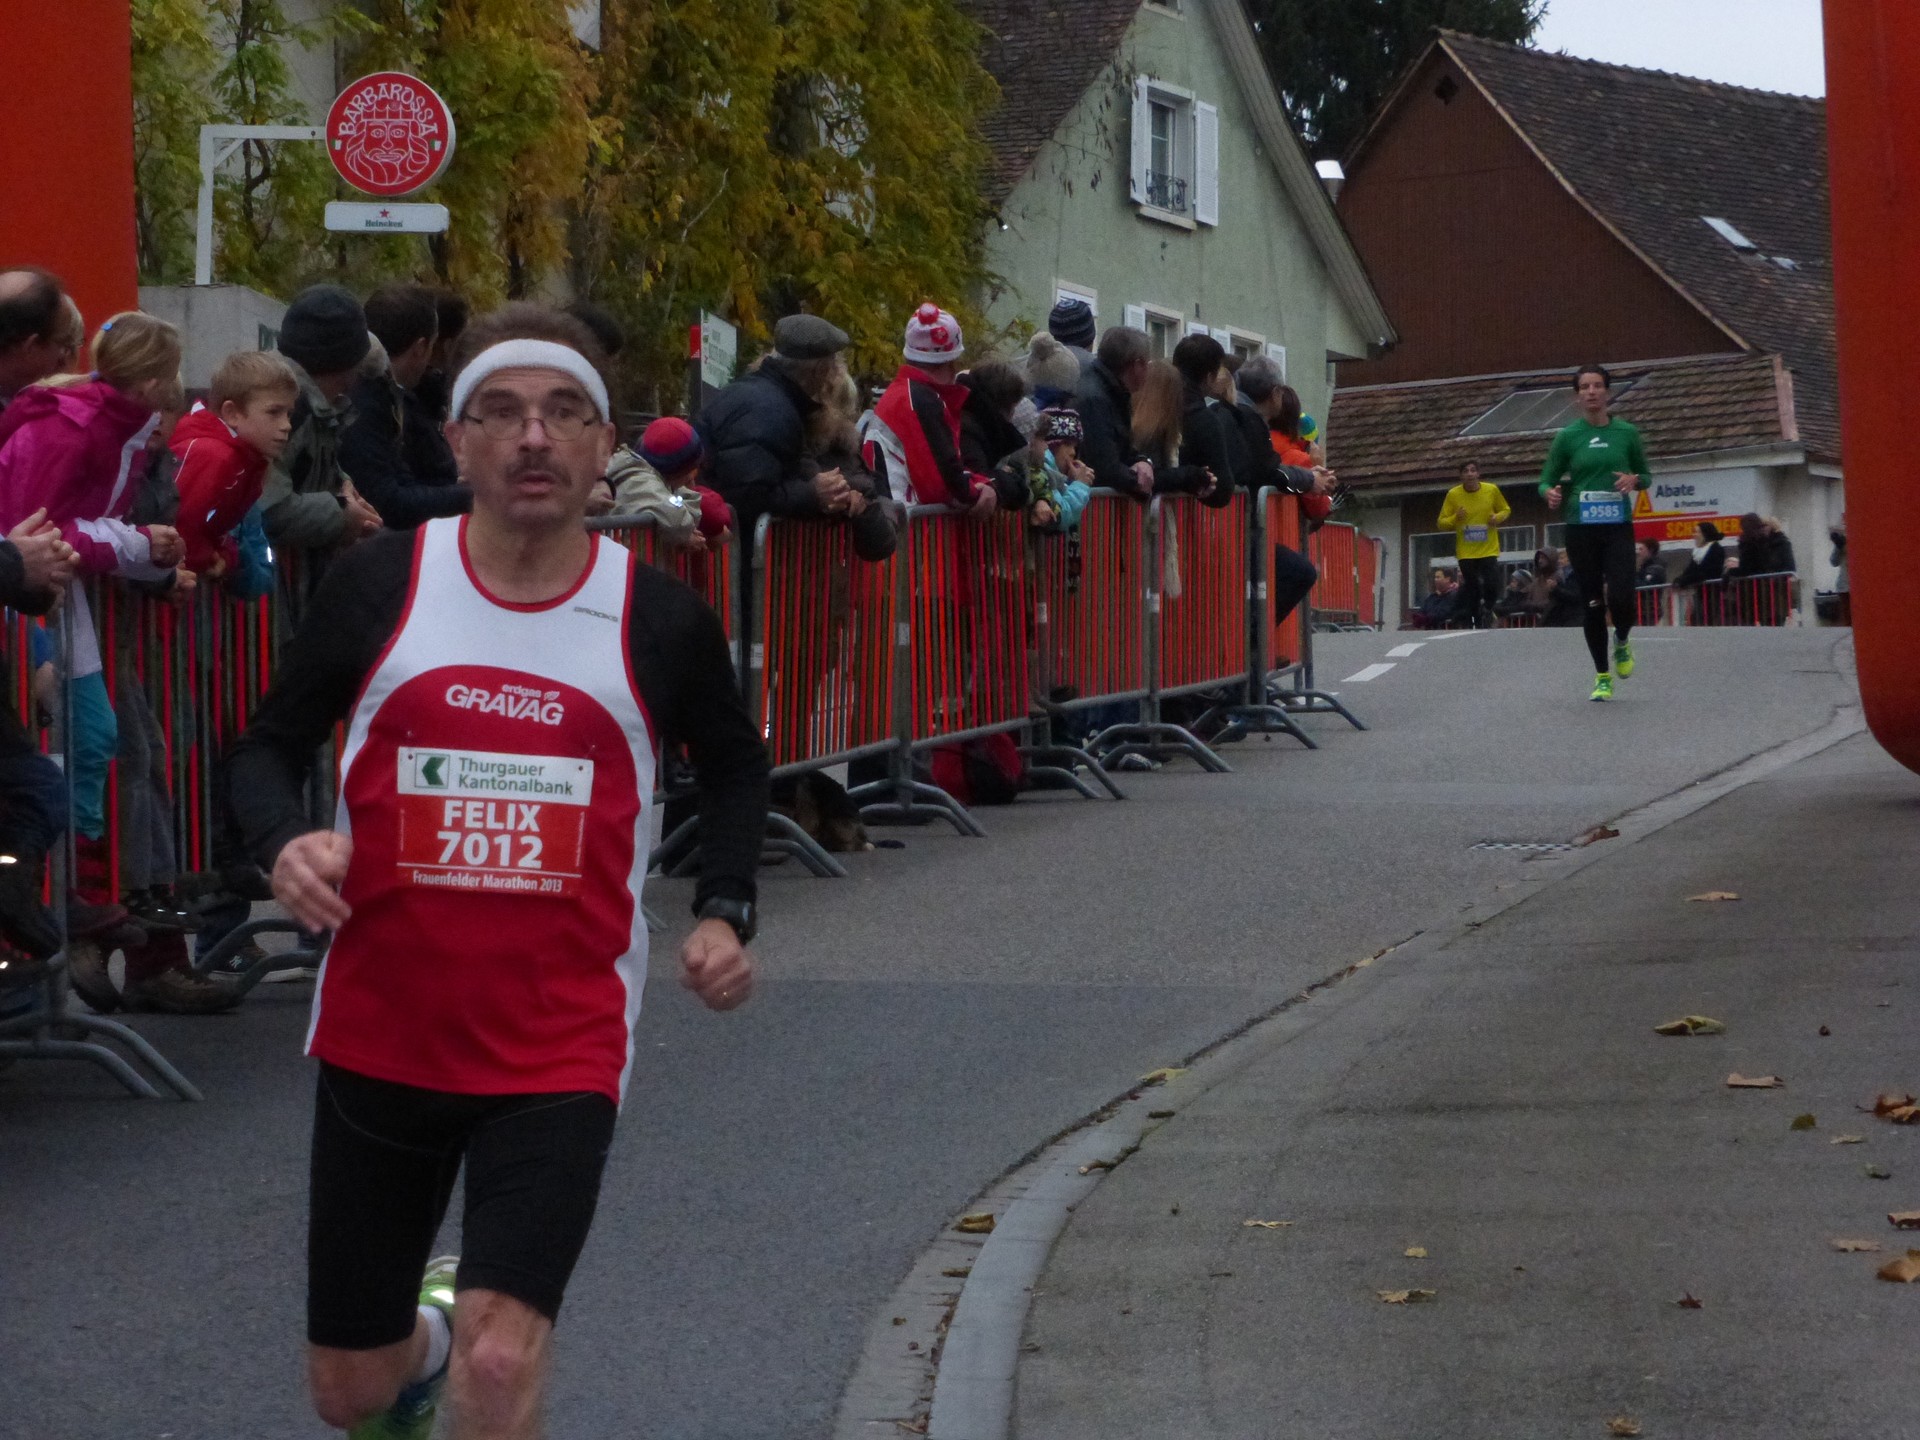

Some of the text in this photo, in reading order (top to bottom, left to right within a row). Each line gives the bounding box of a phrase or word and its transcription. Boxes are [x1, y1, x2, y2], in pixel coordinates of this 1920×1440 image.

[338, 82, 438, 137] BARBAROSSA
[365, 219, 403, 228] Heineken
[1655, 483, 1695, 498] Abate
[1590, 505, 1619, 518] 9585
[501, 683, 542, 698] erdgas
[445, 684, 565, 726] GRAVAG
[458, 757, 545, 777] Thurgauer
[458, 774, 573, 796] Kantonalbank
[443, 800, 541, 832] FELIX
[437, 831, 544, 869] 7012
[412, 870, 562, 893] Frauenfelder Marathon 2013
